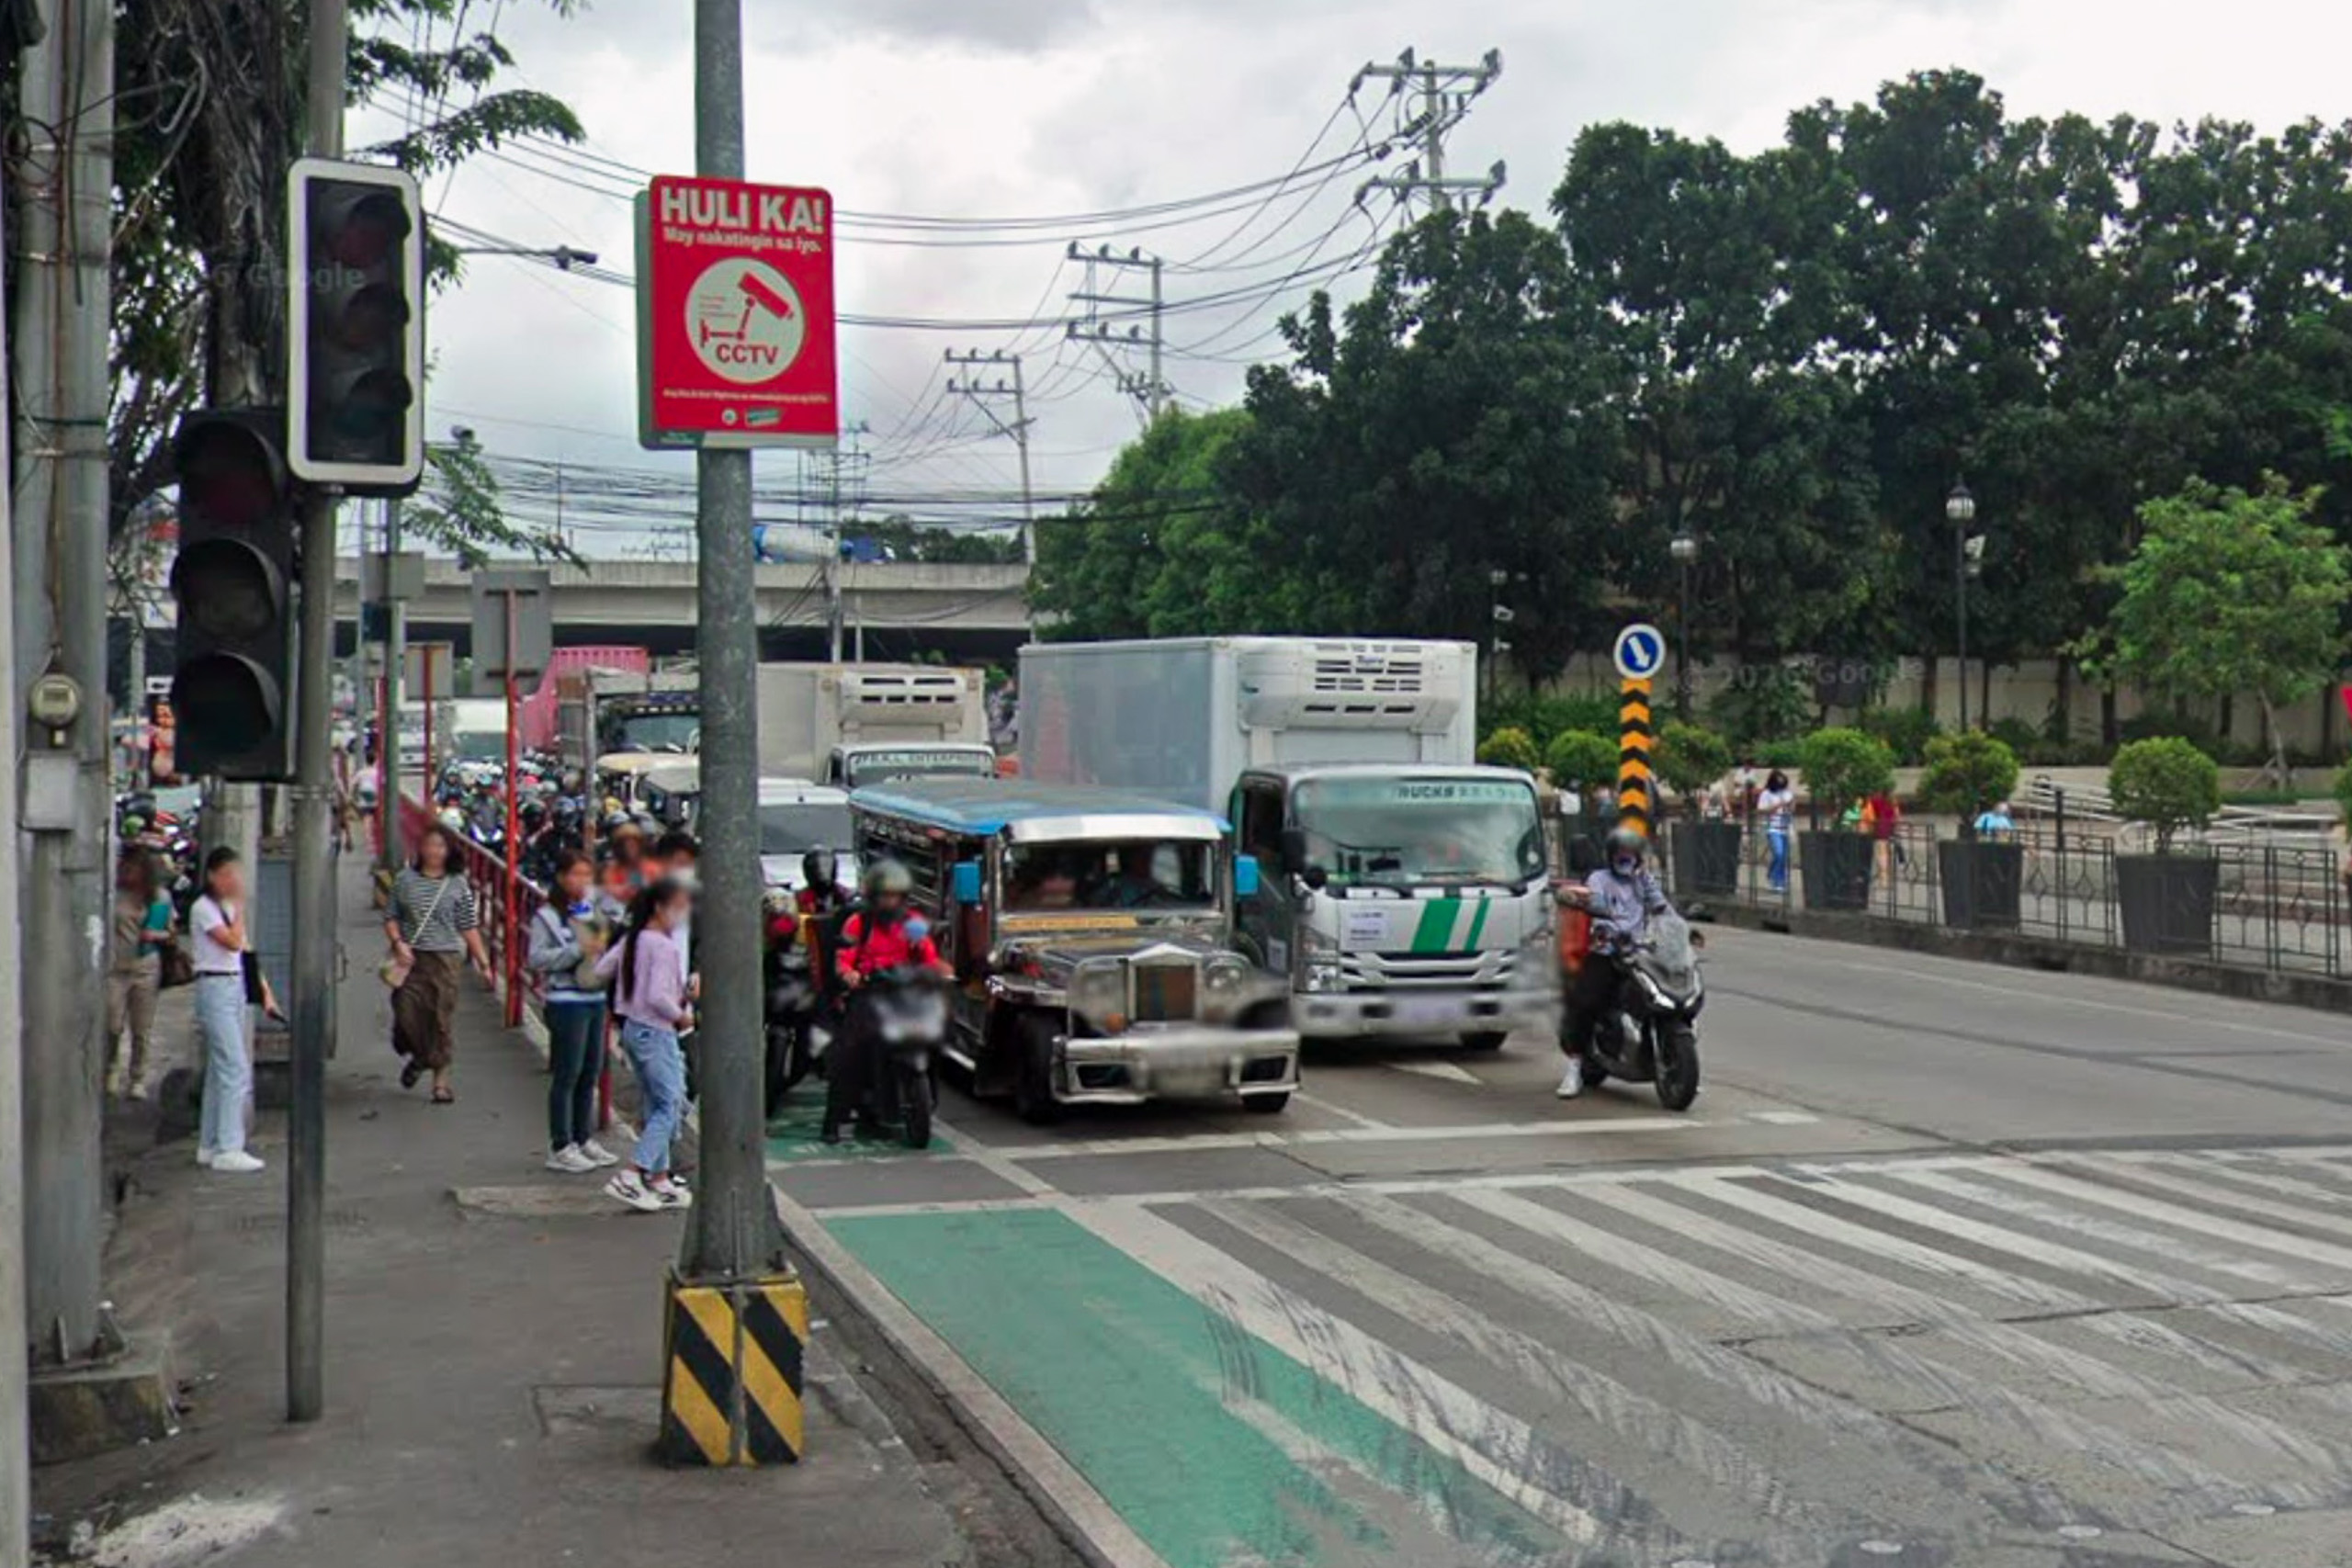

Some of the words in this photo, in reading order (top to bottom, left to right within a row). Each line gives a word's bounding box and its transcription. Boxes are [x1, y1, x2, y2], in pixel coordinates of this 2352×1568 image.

[661, 186, 750, 229] HULI
[759, 193, 824, 234] KA!
[663, 227, 694, 248] May
[696, 230, 774, 253] nakatingin
[776, 237, 794, 251] sa
[716, 343, 779, 366] CCTV
